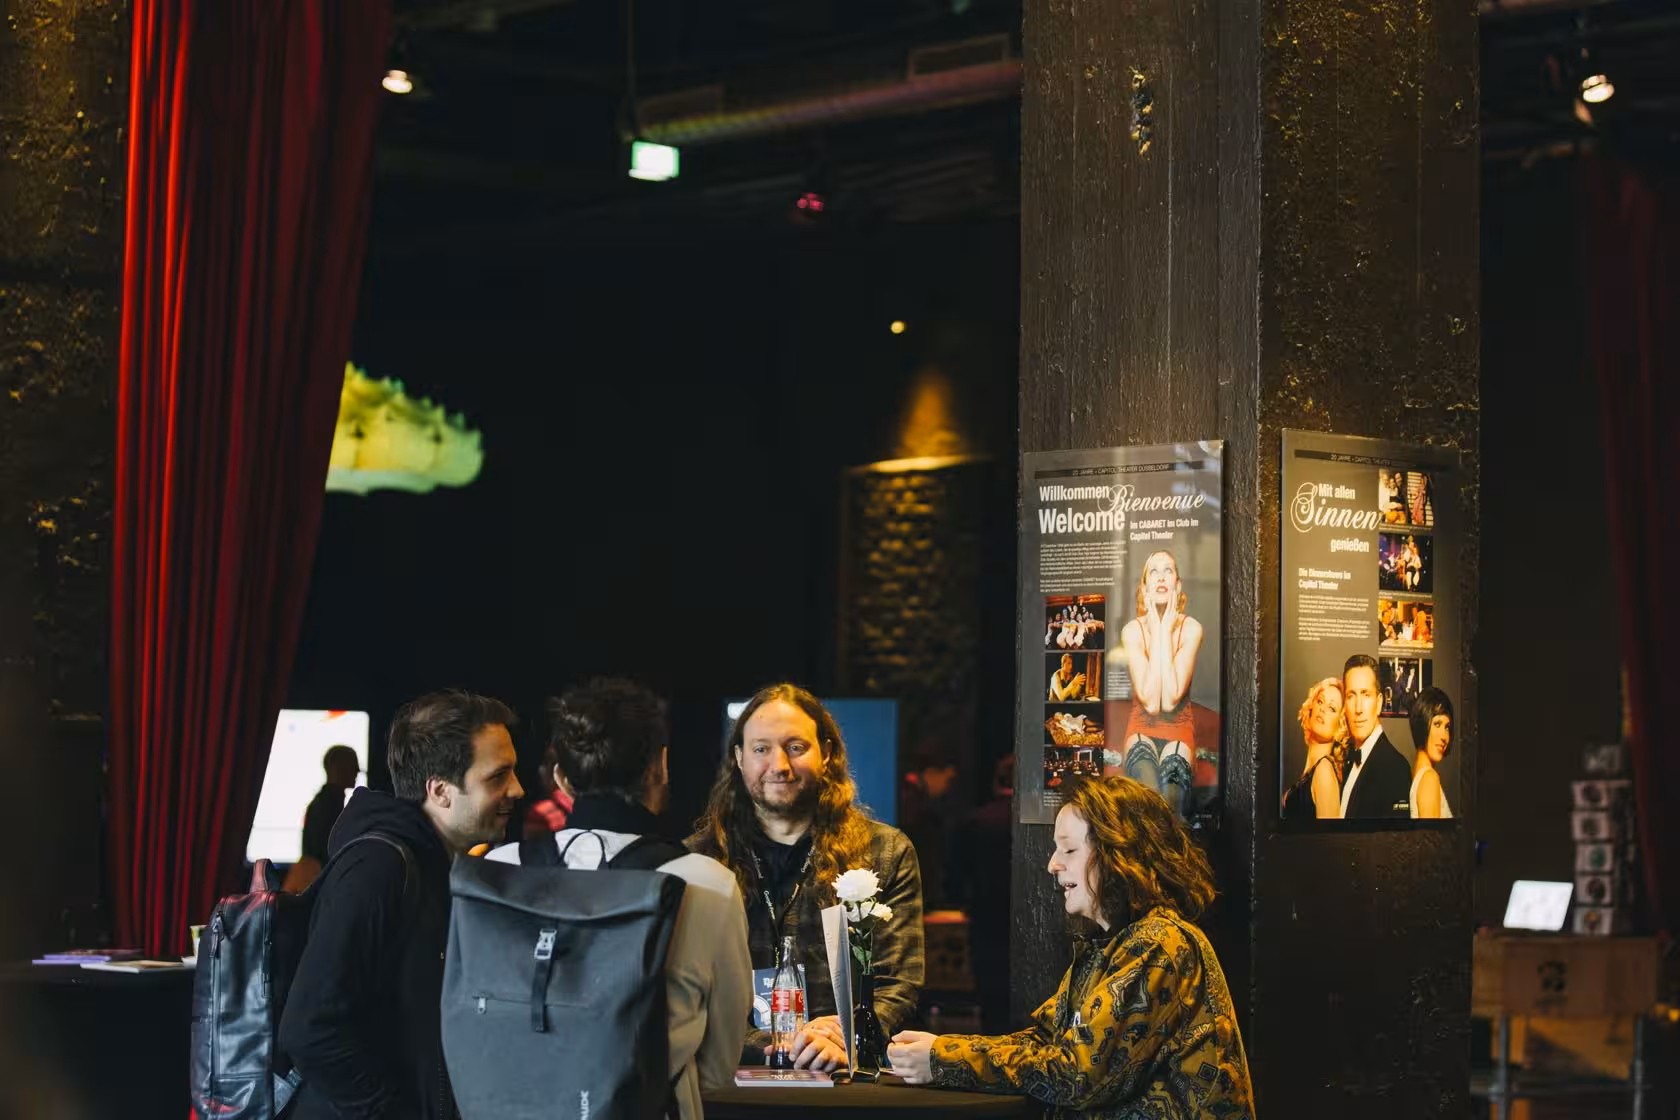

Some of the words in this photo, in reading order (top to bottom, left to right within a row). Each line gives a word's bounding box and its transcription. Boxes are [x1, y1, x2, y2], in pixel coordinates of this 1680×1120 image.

[1039, 485, 1109, 502] Willkommen
[1097, 484, 1207, 513] Bienvenue
[1318, 483, 1333, 498] Mit
[1334, 485, 1356, 500] allen
[1290, 482, 1382, 533] Sinnen
[1038, 507, 1126, 534] Welcome
[1139, 519, 1167, 529] CABARET
[1176, 518, 1190, 528] Club
[1330, 537, 1370, 553] genießen
